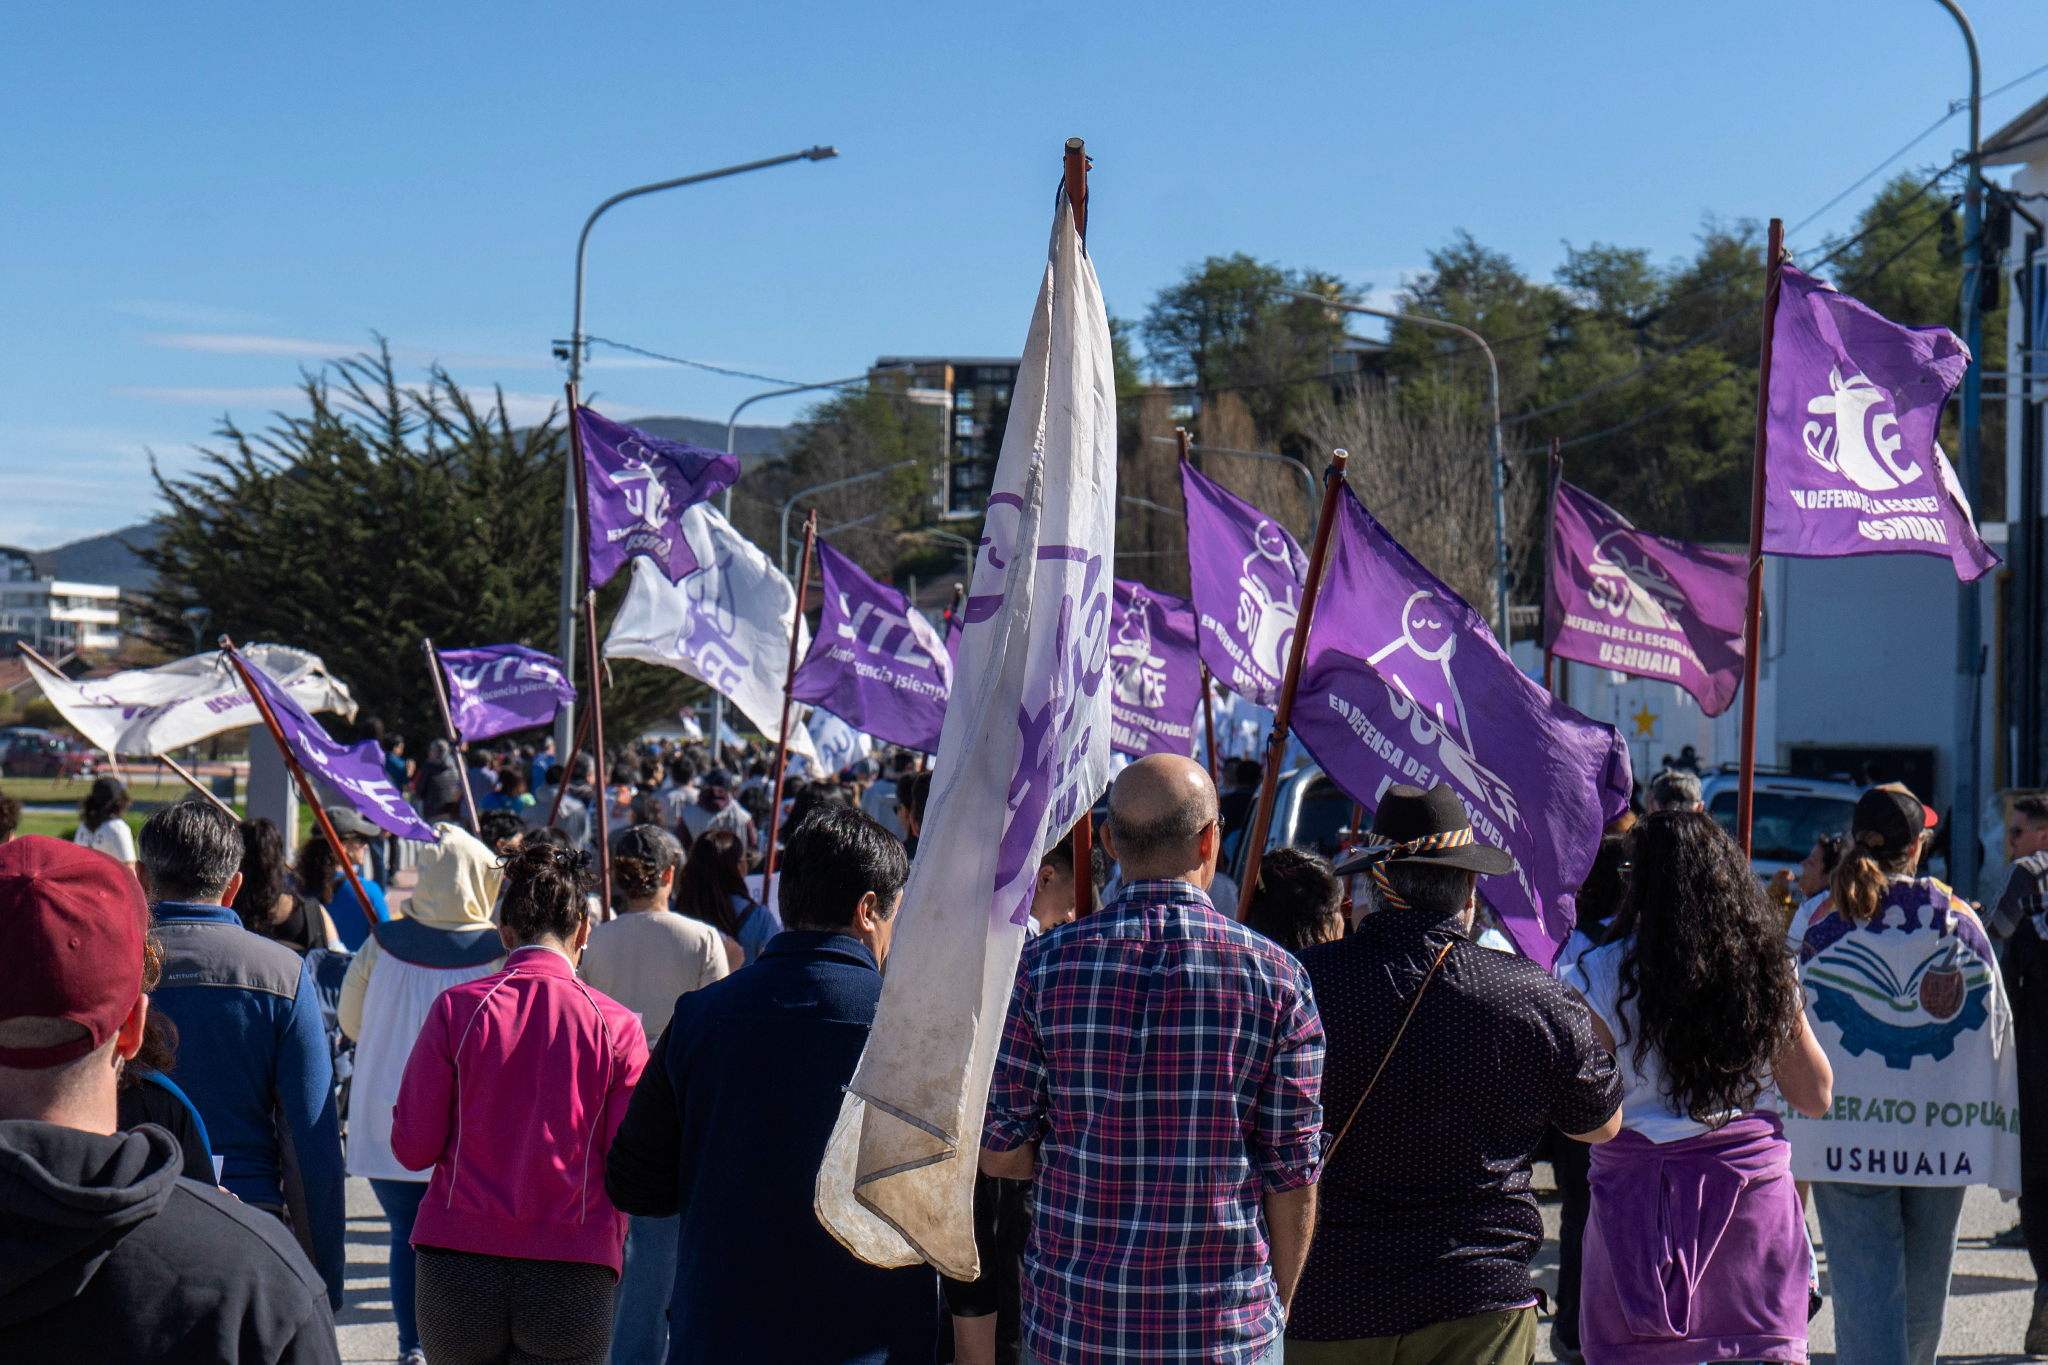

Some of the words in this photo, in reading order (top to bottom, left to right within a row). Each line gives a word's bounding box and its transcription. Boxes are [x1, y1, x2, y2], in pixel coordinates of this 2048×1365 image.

[1806, 489, 1863, 509] DEFENSA
[1857, 515, 1949, 546] USHUAI
[1201, 613, 1217, 631] EN
[1611, 625, 1627, 641] DE
[1627, 629, 1643, 644] LA
[1598, 641, 1682, 677] USHUAIA
[1328, 692, 1350, 719] EN
[1347, 705, 1405, 770] DEFENSA
[1402, 756, 1431, 786] DE
[168, 972, 199, 980] ALTITUDE
[1825, 1146, 1974, 1177] USHUAIA
